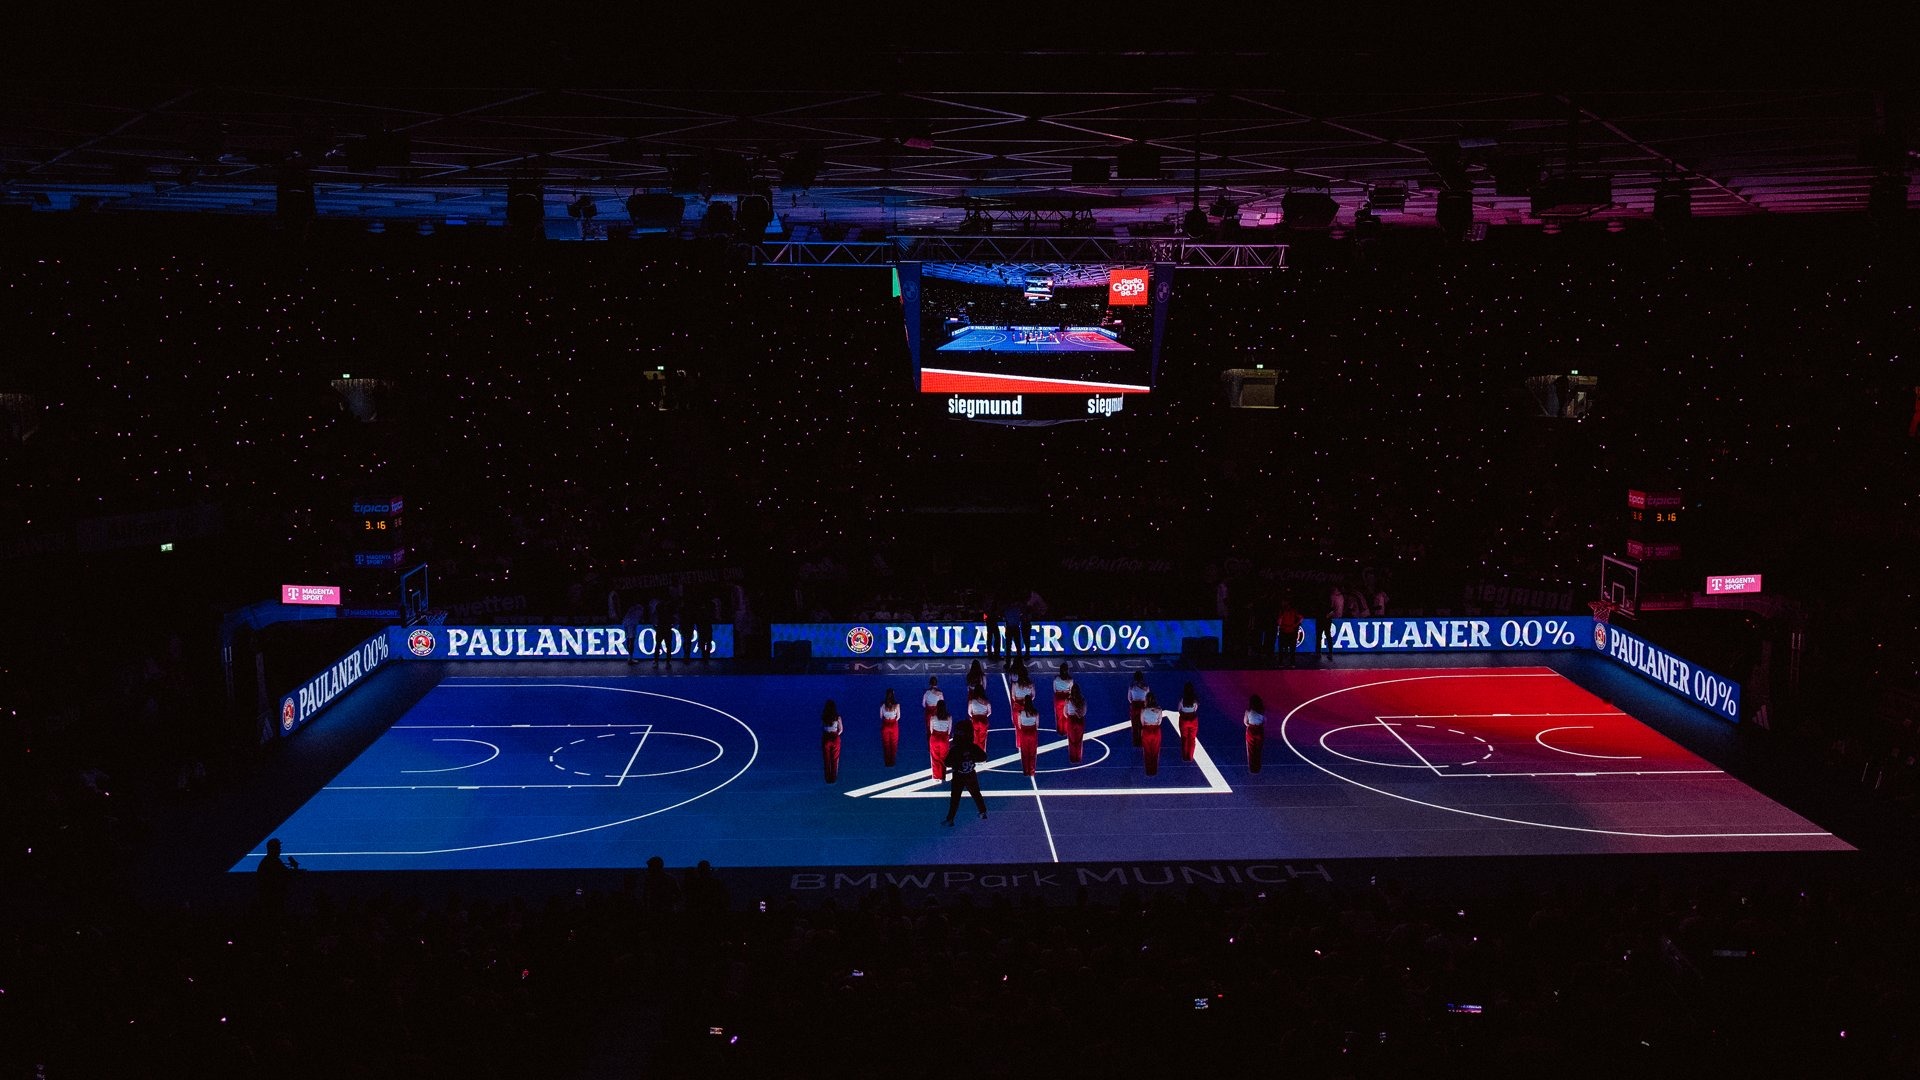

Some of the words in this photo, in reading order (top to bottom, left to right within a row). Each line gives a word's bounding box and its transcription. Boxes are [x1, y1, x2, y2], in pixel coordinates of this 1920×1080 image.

[1112, 282, 1145, 292] Gong
[948, 394, 1022, 418] siegmund
[352, 502, 390, 514] tipico
[447, 628, 629, 656] PAULANER
[1073, 624, 1150, 652] 0,0%
[1500, 620, 1575, 647] 0,0%
[1610, 628, 1690, 695] PAULANER
[299, 650, 362, 722] PAULANER
[790, 869, 1061, 890] BMWPark
[1075, 864, 1334, 886] MUNICH
